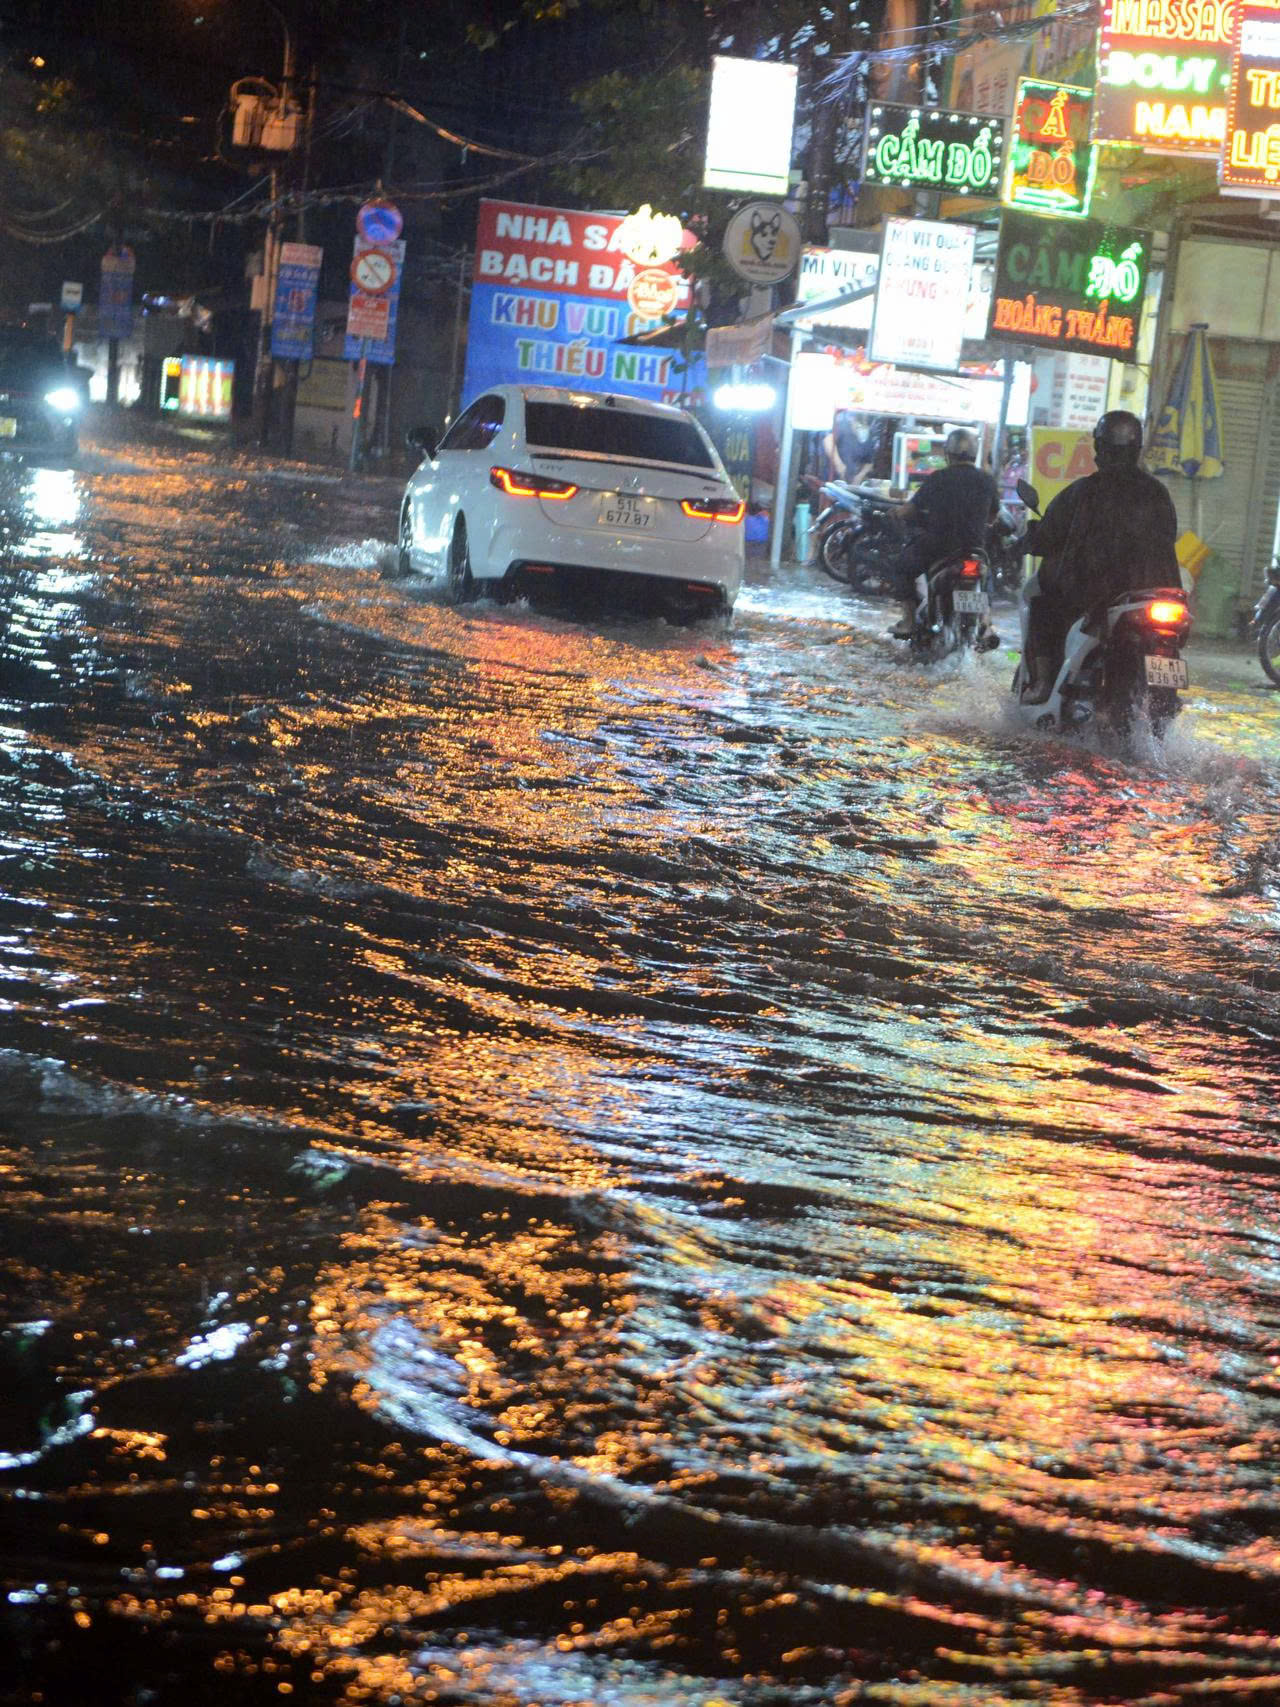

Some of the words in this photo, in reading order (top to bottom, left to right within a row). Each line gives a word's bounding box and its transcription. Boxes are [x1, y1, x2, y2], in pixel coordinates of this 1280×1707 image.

[496, 211, 572, 246] NHÀ
[480, 250, 580, 286] BẠCH
[492, 292, 560, 329] KHU
[564, 302, 619, 338] VUI
[516, 337, 607, 377] THIẾU
